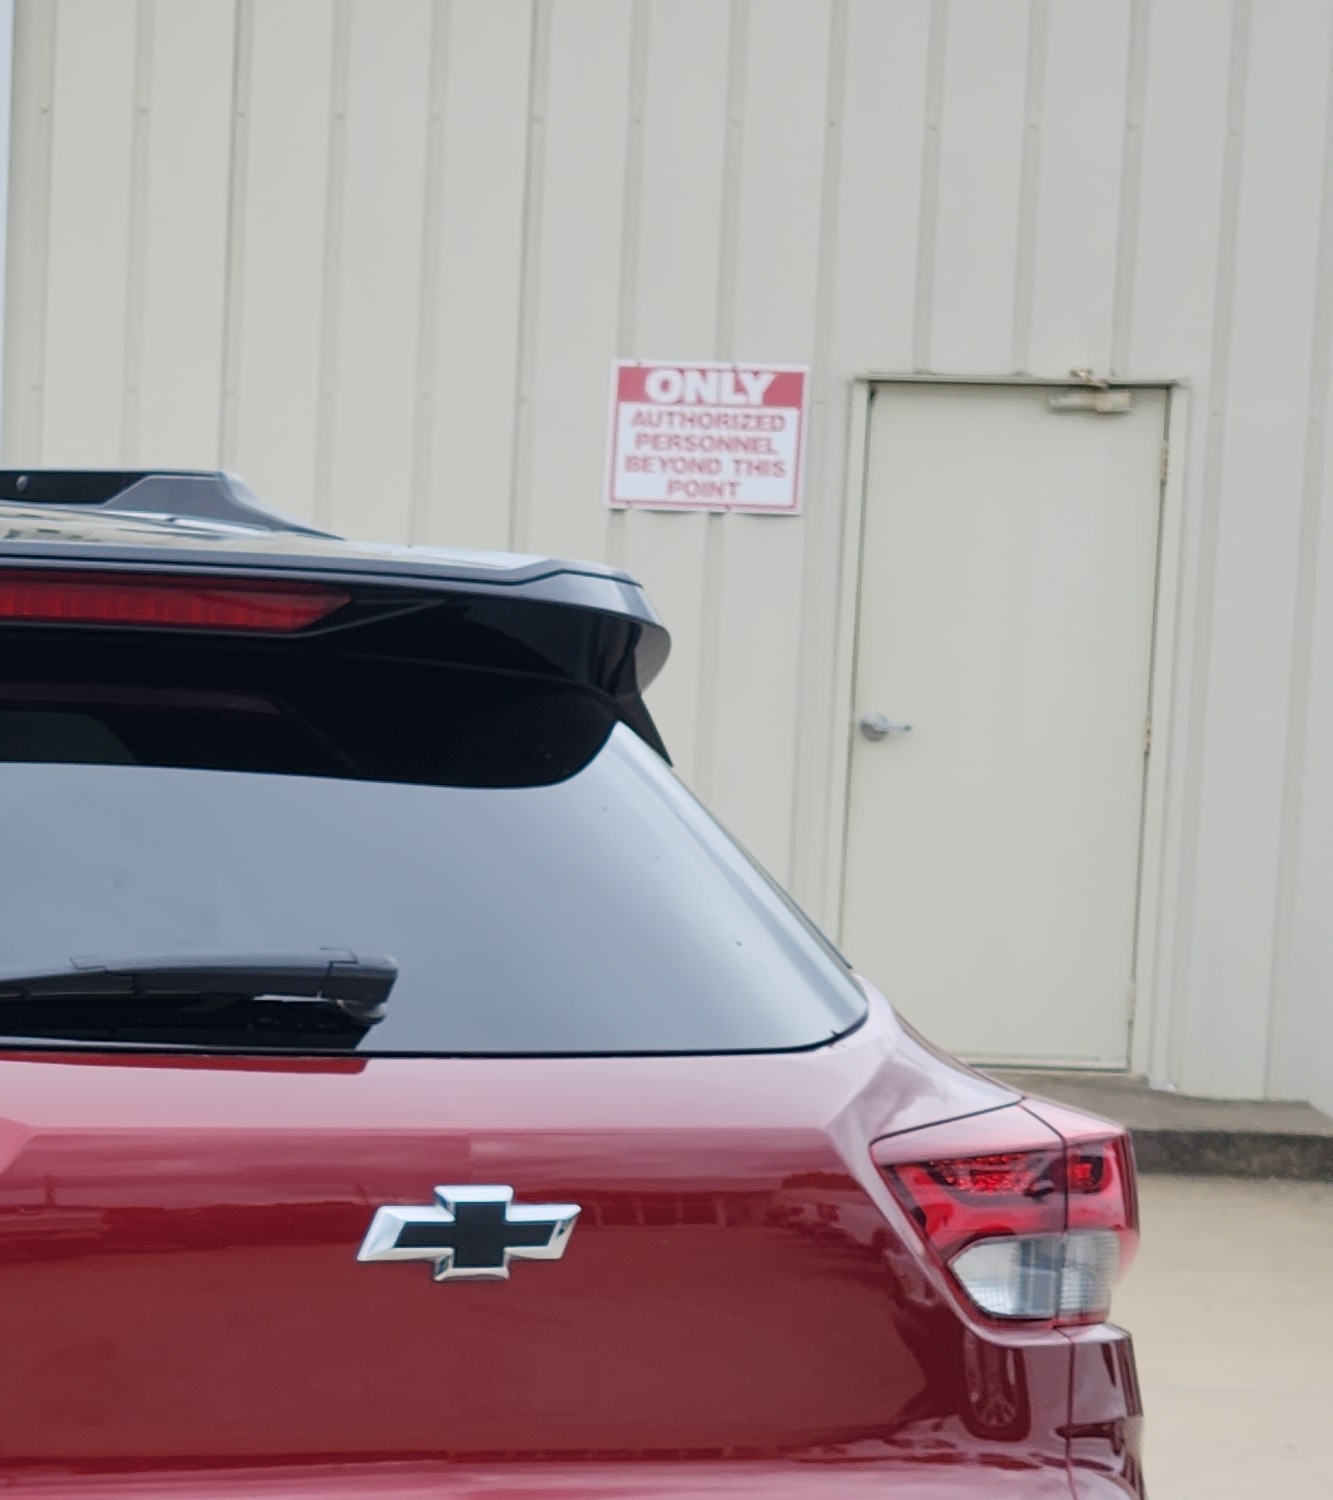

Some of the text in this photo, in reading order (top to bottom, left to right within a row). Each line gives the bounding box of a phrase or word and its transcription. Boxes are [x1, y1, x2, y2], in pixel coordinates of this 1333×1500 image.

[645, 369, 778, 406] ONLY
[633, 410, 786, 432] AUTHORIZED
[635, 432, 777, 455] PERSONNEL
[624, 455, 786, 478] BEYOND THIS
[667, 480, 742, 499] POINT
